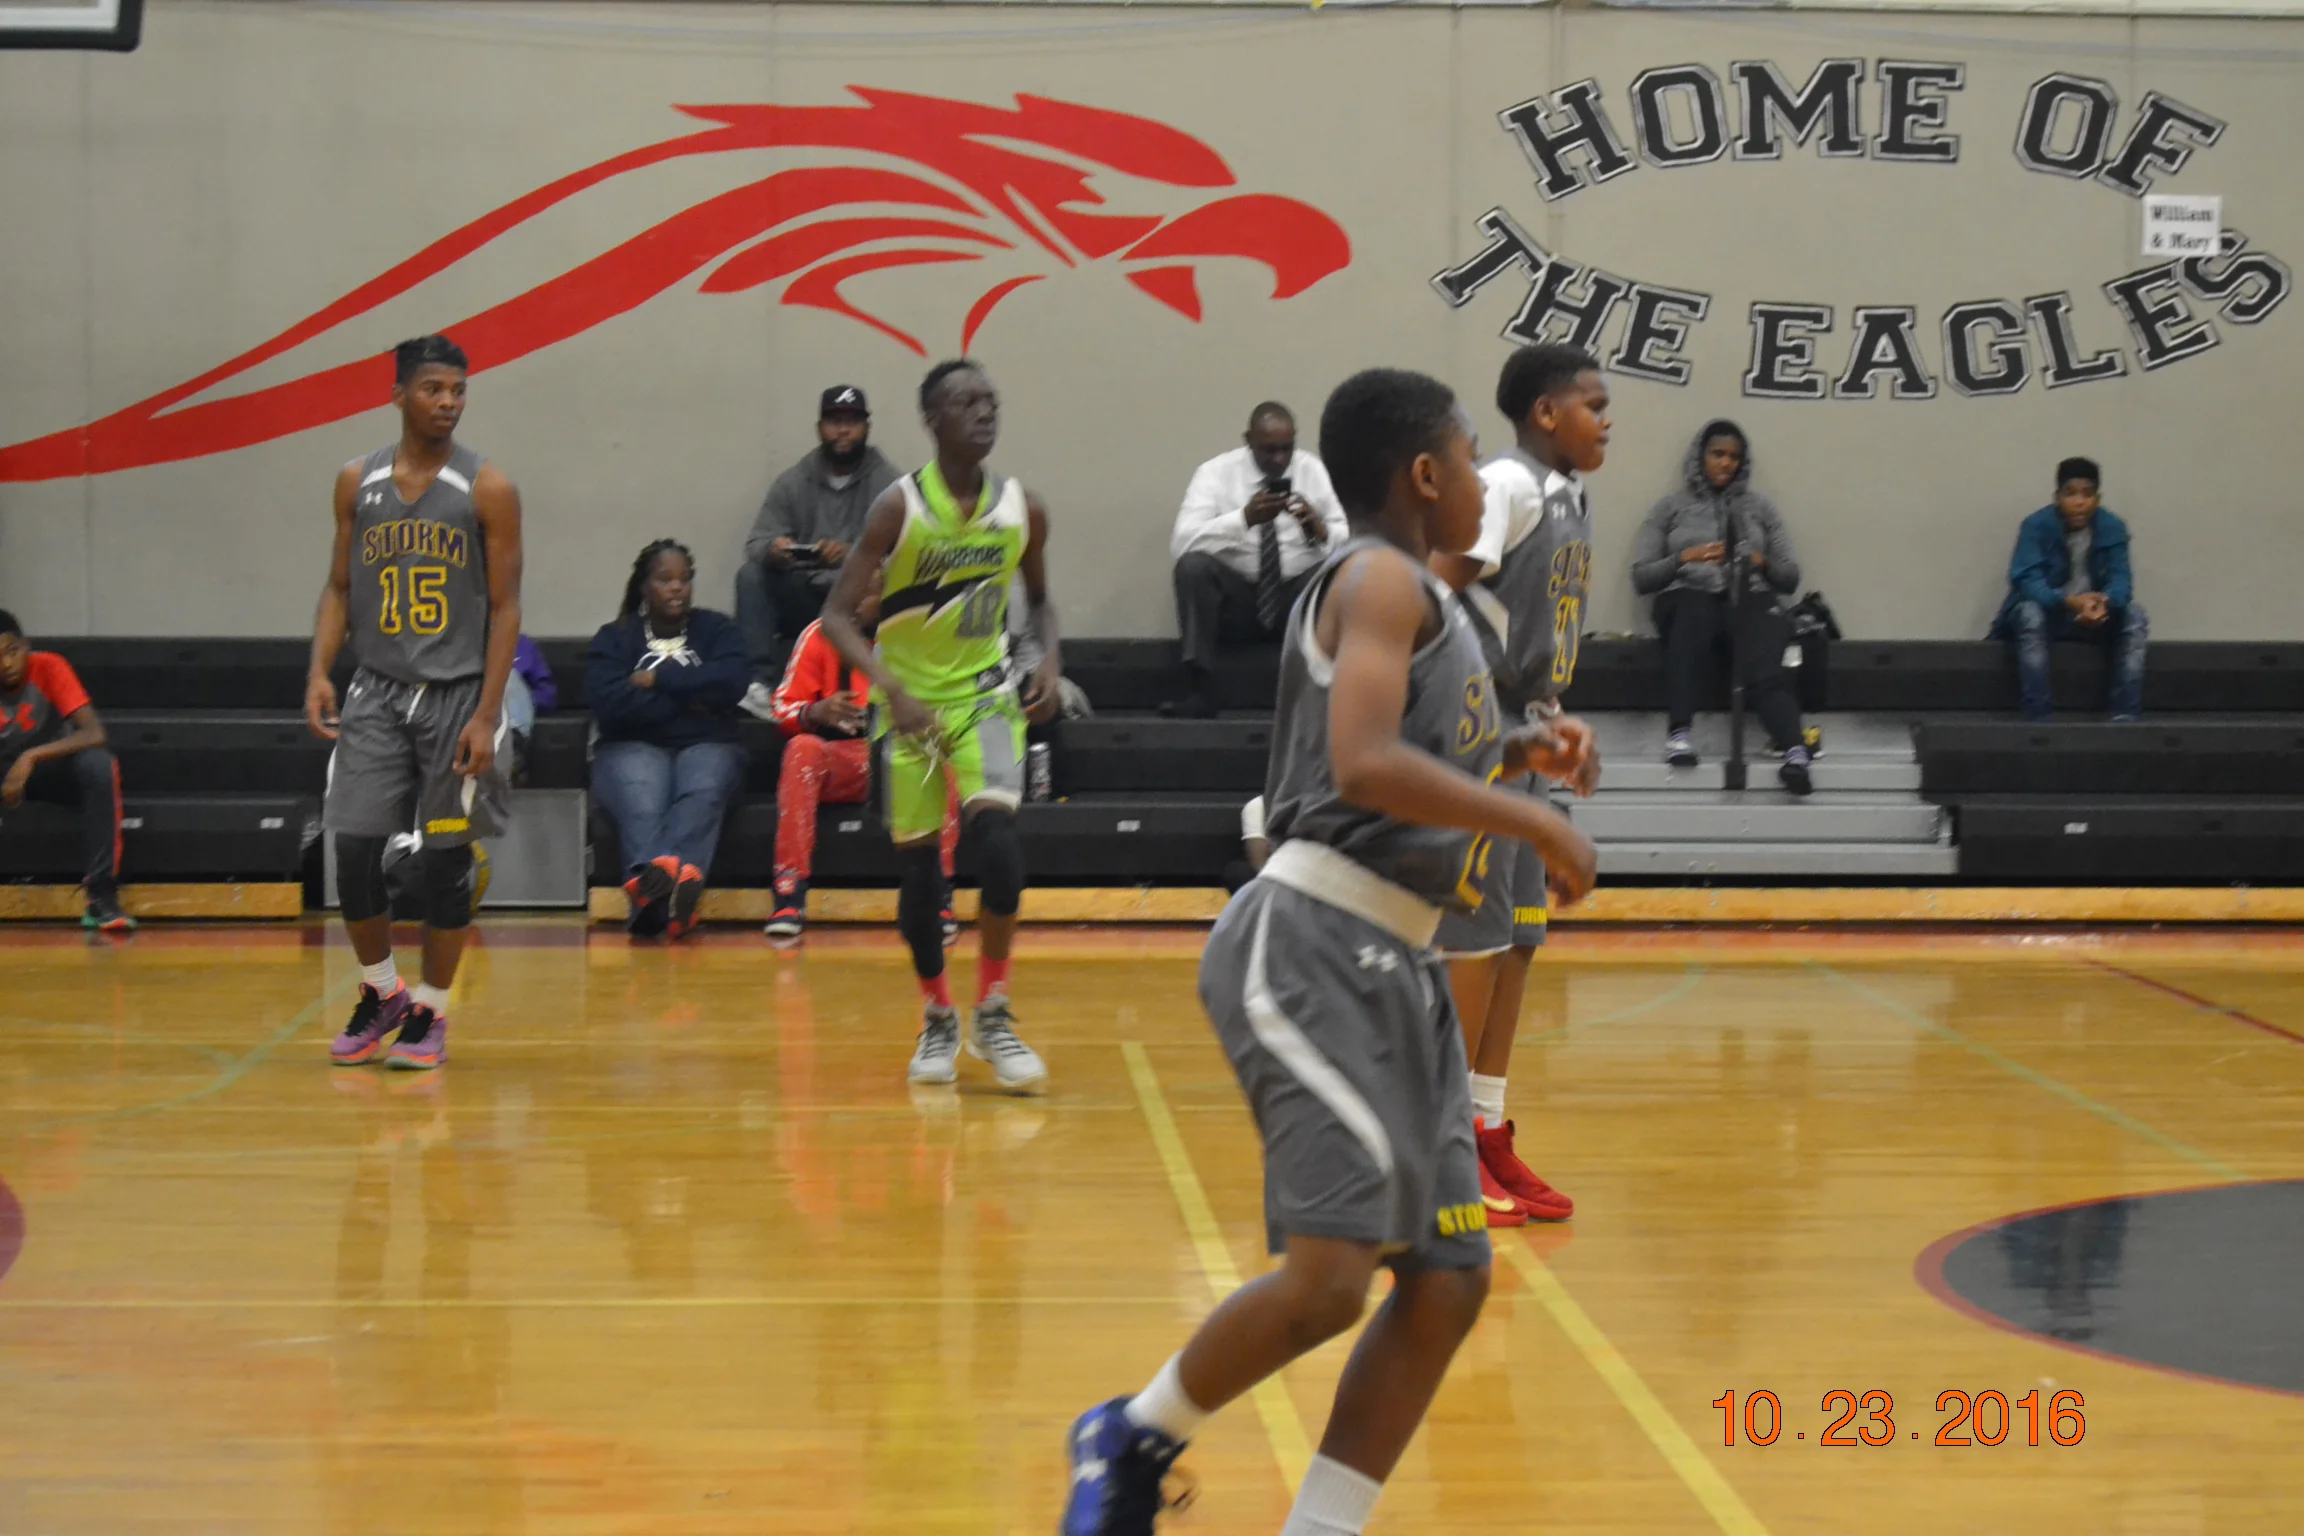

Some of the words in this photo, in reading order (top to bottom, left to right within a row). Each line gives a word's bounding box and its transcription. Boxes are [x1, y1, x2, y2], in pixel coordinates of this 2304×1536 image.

[1497, 57, 1967, 202] HOME
[2012, 72, 2227, 198] OF
[2150, 204, 2213, 222] William
[2152, 232, 2164, 249] &
[2168, 232, 2213, 253] Mary
[1429, 206, 1712, 386] THE
[1742, 229, 2294, 400] EAGLES
[362, 518, 468, 569] STORM
[379, 565, 449, 635] 15
[1514, 906, 1548, 926] TORM
